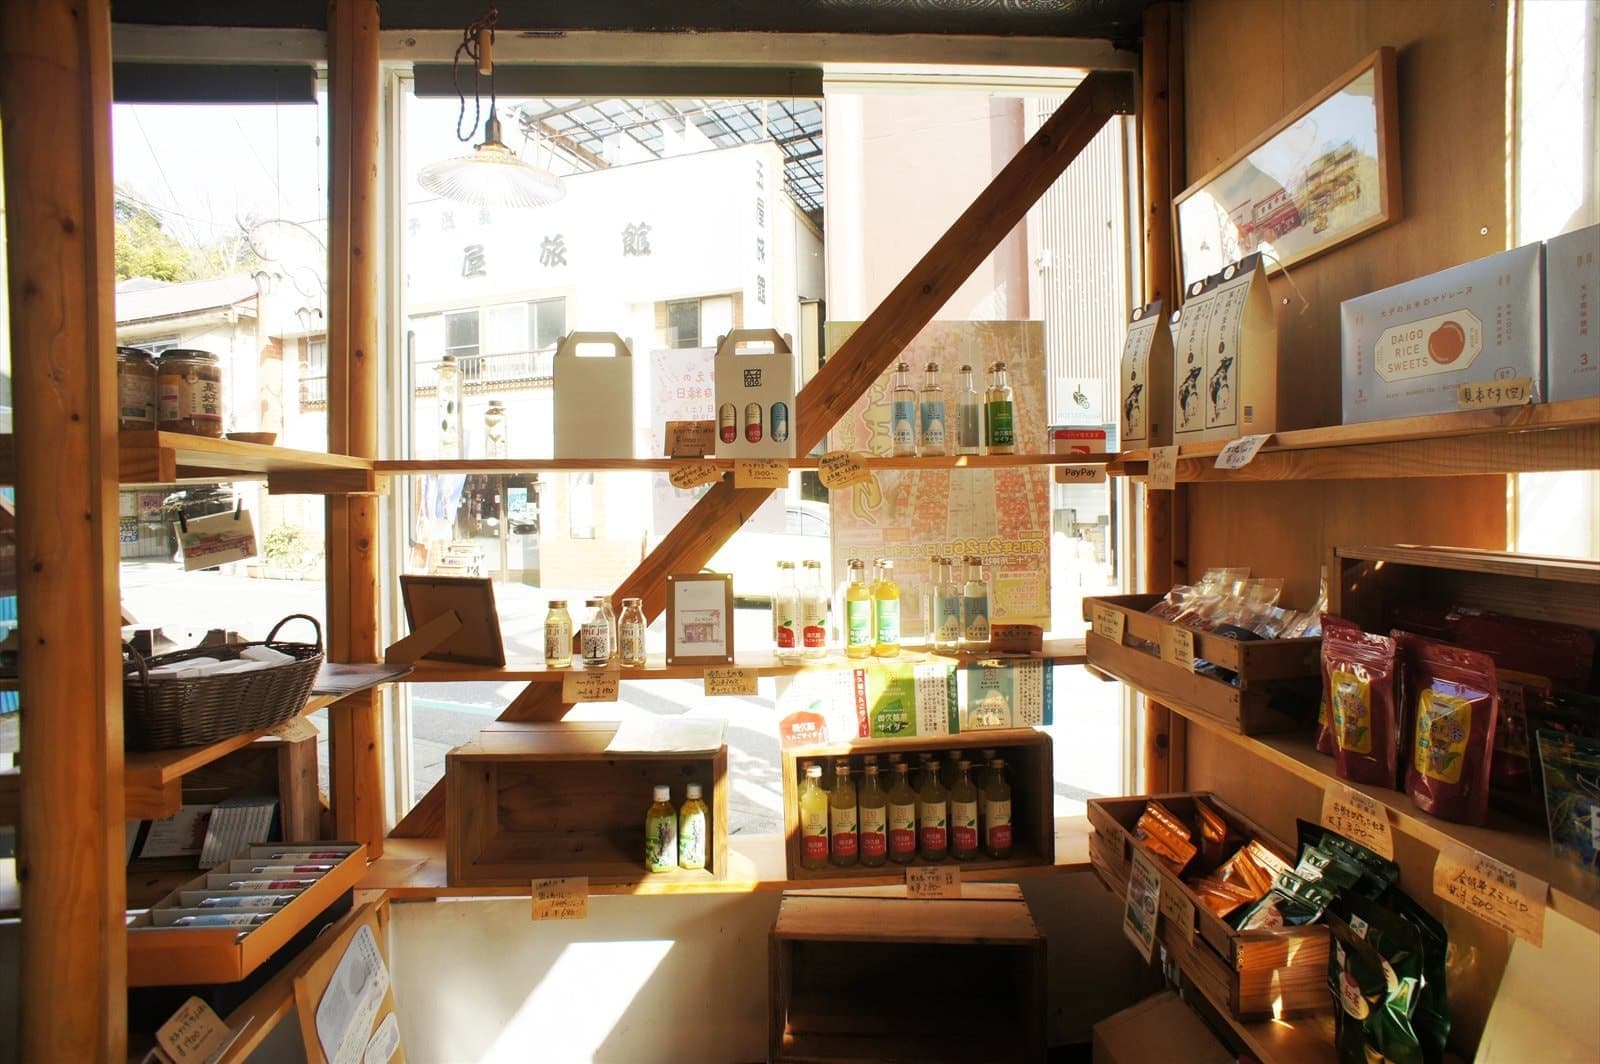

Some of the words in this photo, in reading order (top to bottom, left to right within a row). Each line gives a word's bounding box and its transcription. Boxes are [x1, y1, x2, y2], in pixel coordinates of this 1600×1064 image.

[1391, 328, 1424, 346] DAIGO
[1395, 345, 1421, 358] RICE
[1387, 356, 1430, 374] SWEETS
[1065, 467, 1097, 478] PayPay
